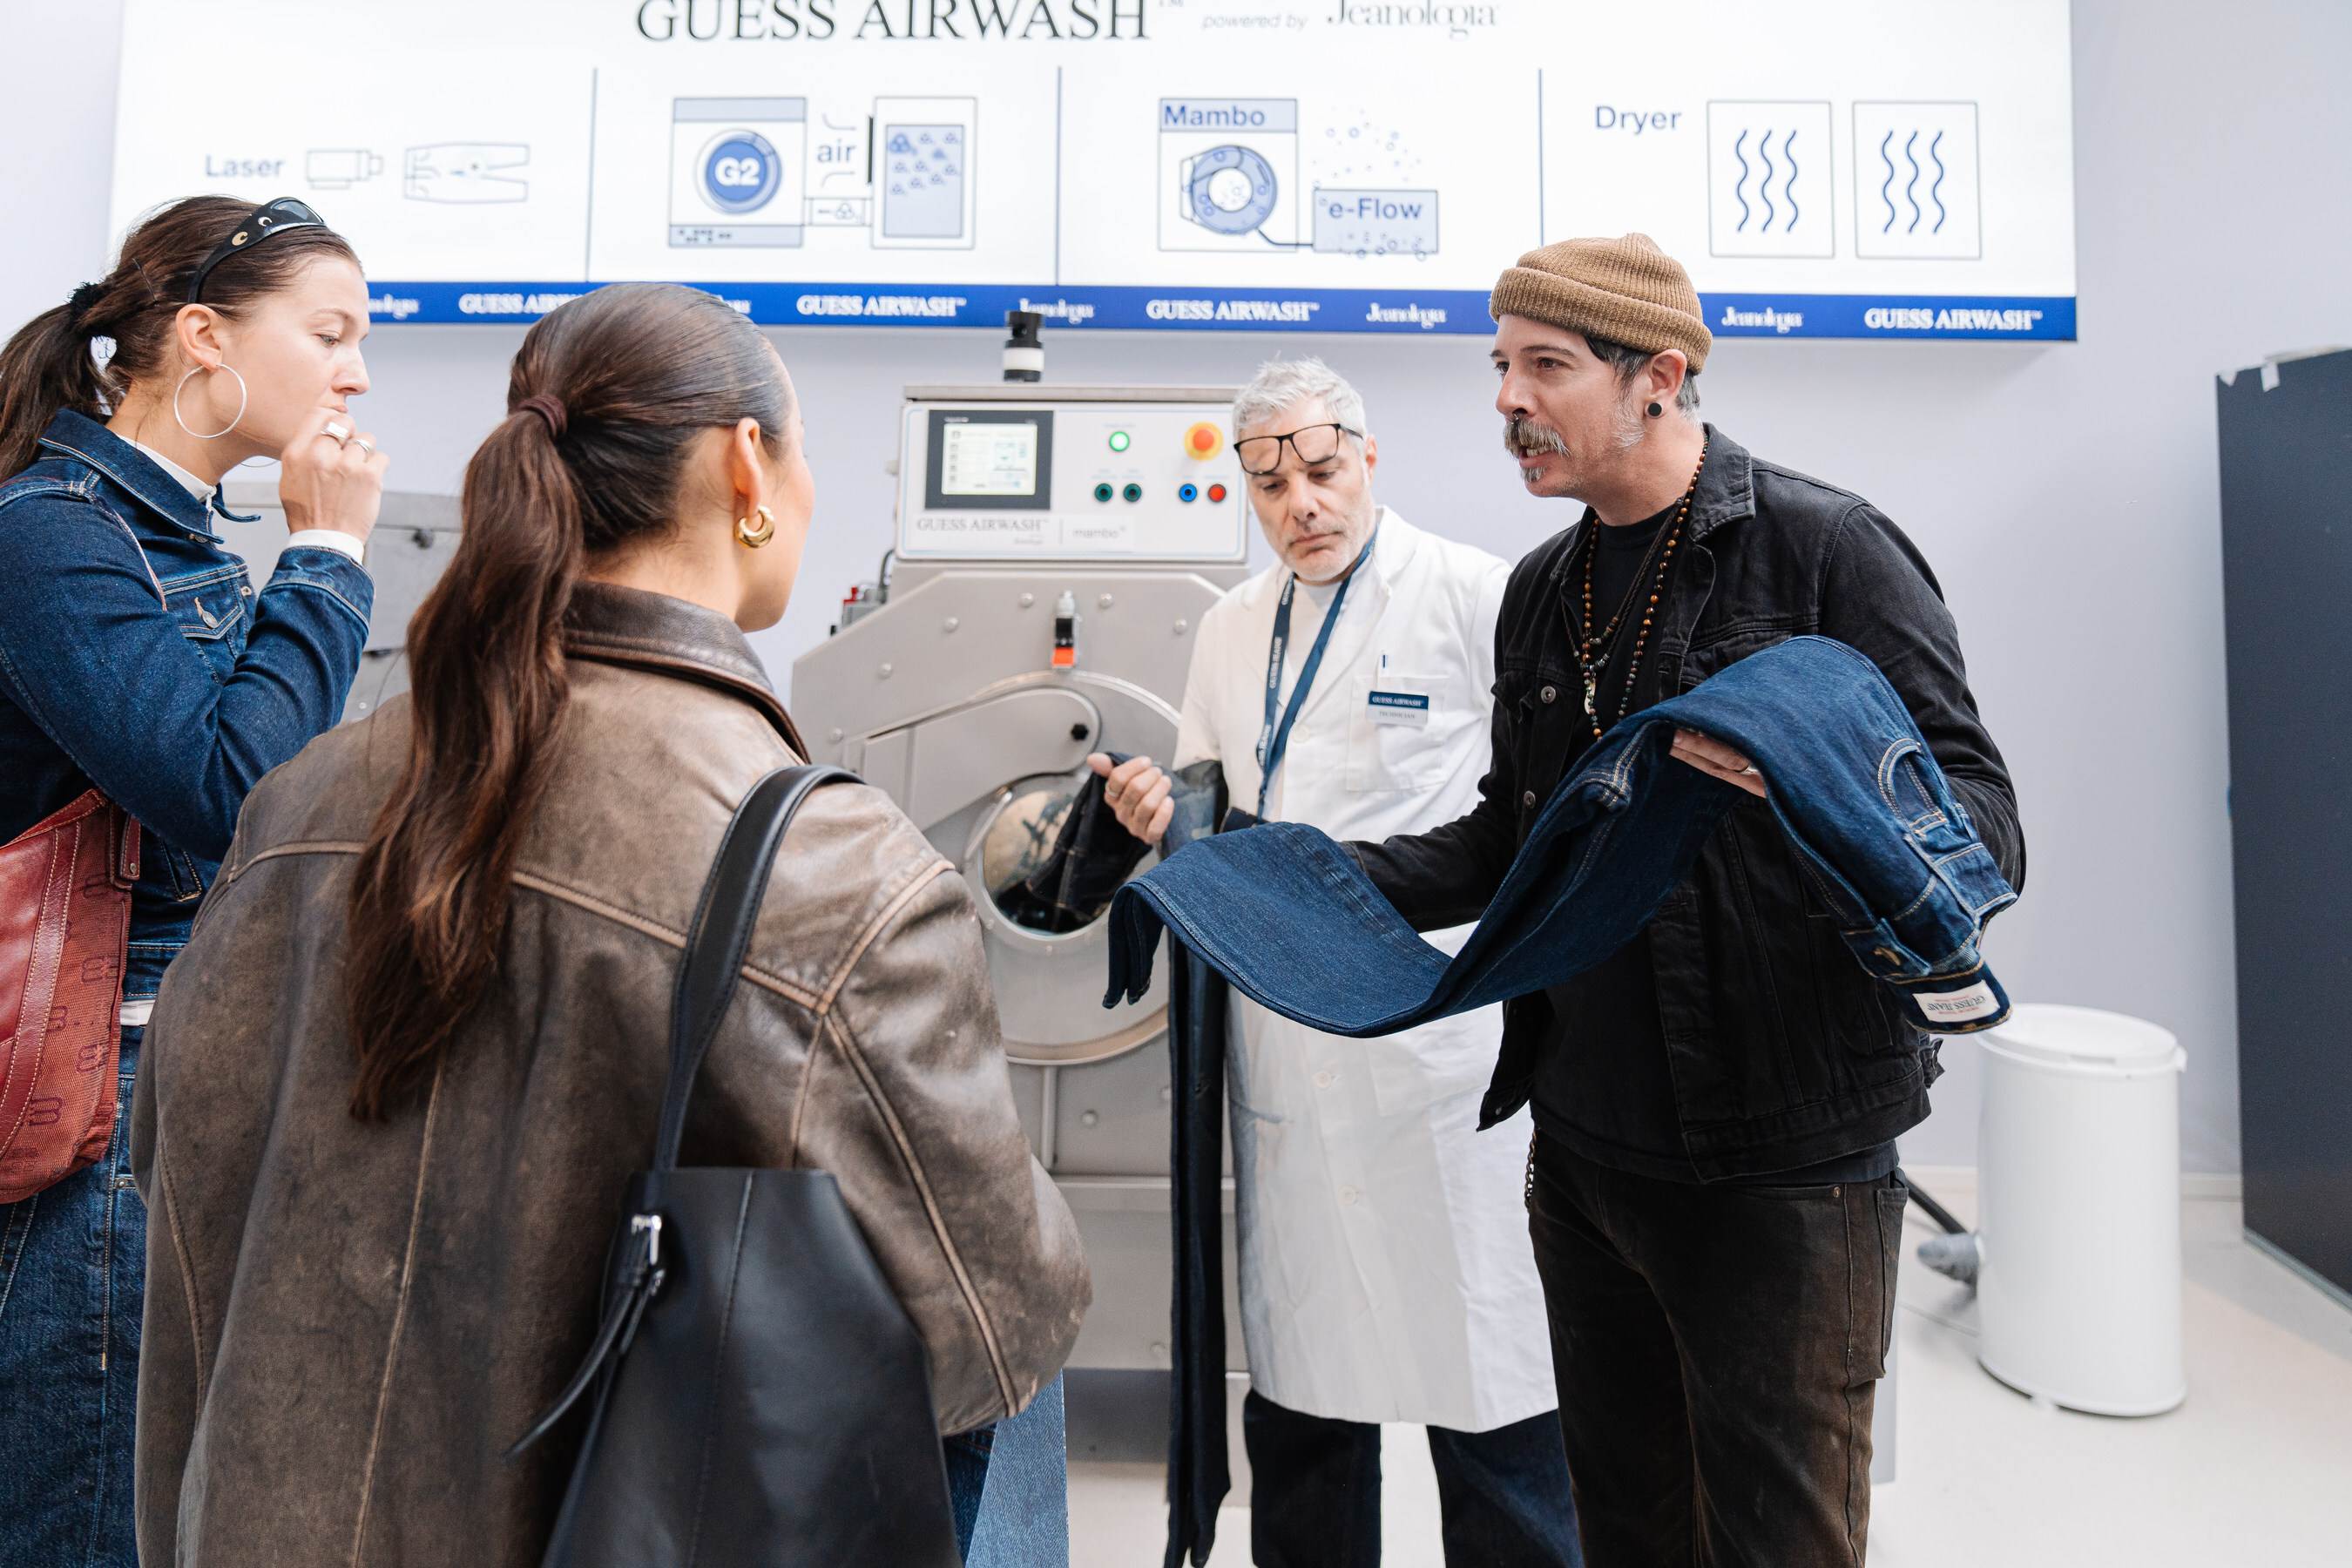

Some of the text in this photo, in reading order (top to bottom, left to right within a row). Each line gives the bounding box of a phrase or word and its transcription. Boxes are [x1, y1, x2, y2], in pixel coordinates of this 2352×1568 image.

[637, 0, 835, 40] GUESS
[1201, 10, 1308, 31] powered by
[1327, 0, 1497, 40] Jeanologia
[1165, 105, 1266, 126] Mambo
[1595, 105, 1682, 135] Dryer
[817, 139, 856, 164] air
[206, 153, 285, 178] Laser
[714, 156, 760, 186] G2
[1329, 198, 1422, 220] e-Flow
[458, 293, 523, 314] GUESS
[796, 294, 863, 315] GUESS
[1146, 299, 1216, 320] GUESS
[1864, 308, 1933, 329] GUESS
[916, 518, 967, 531] GUESS
[1927, 1002, 1952, 1011] JEANS
[1953, 995, 1986, 1010] GUESS
